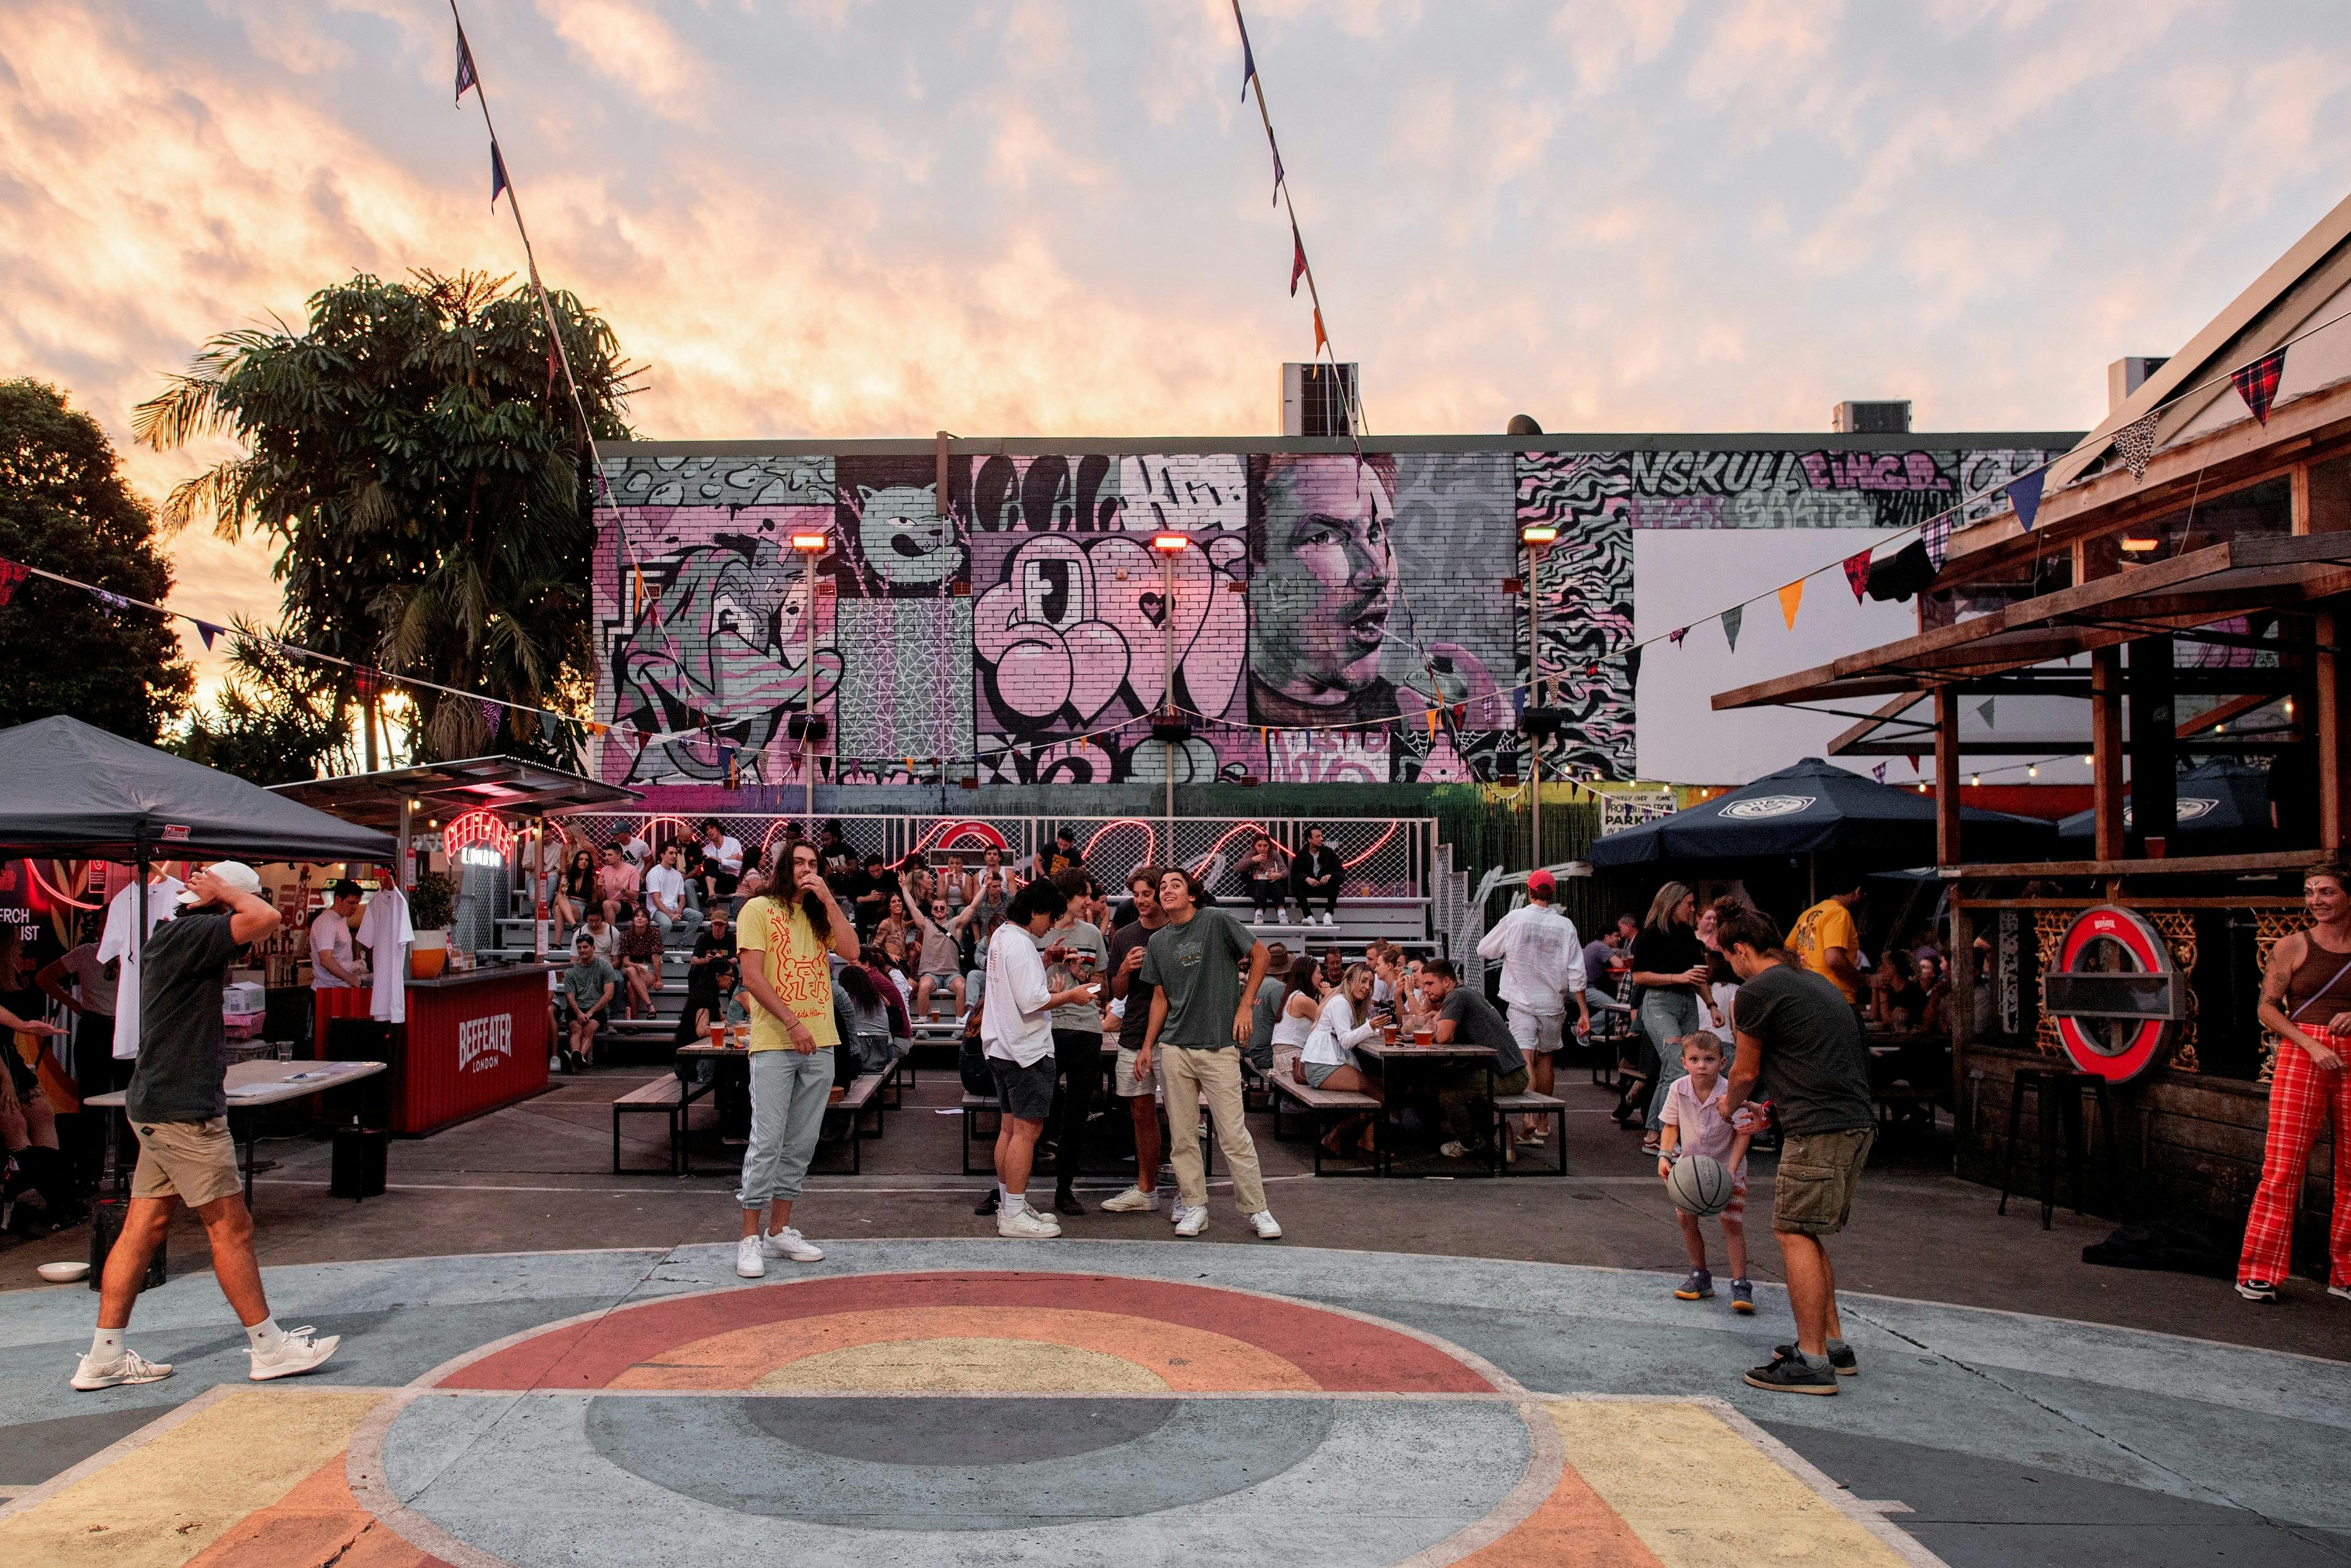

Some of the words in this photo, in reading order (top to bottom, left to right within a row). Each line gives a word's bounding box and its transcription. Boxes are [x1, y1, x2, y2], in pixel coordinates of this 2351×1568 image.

[447, 812, 512, 864] BEEFEATER
[462, 847, 501, 867] LONDON
[21, 925, 40, 941] IST
[459, 1013, 511, 1073] BEEFEATER
[472, 1055, 499, 1073] LONDON
